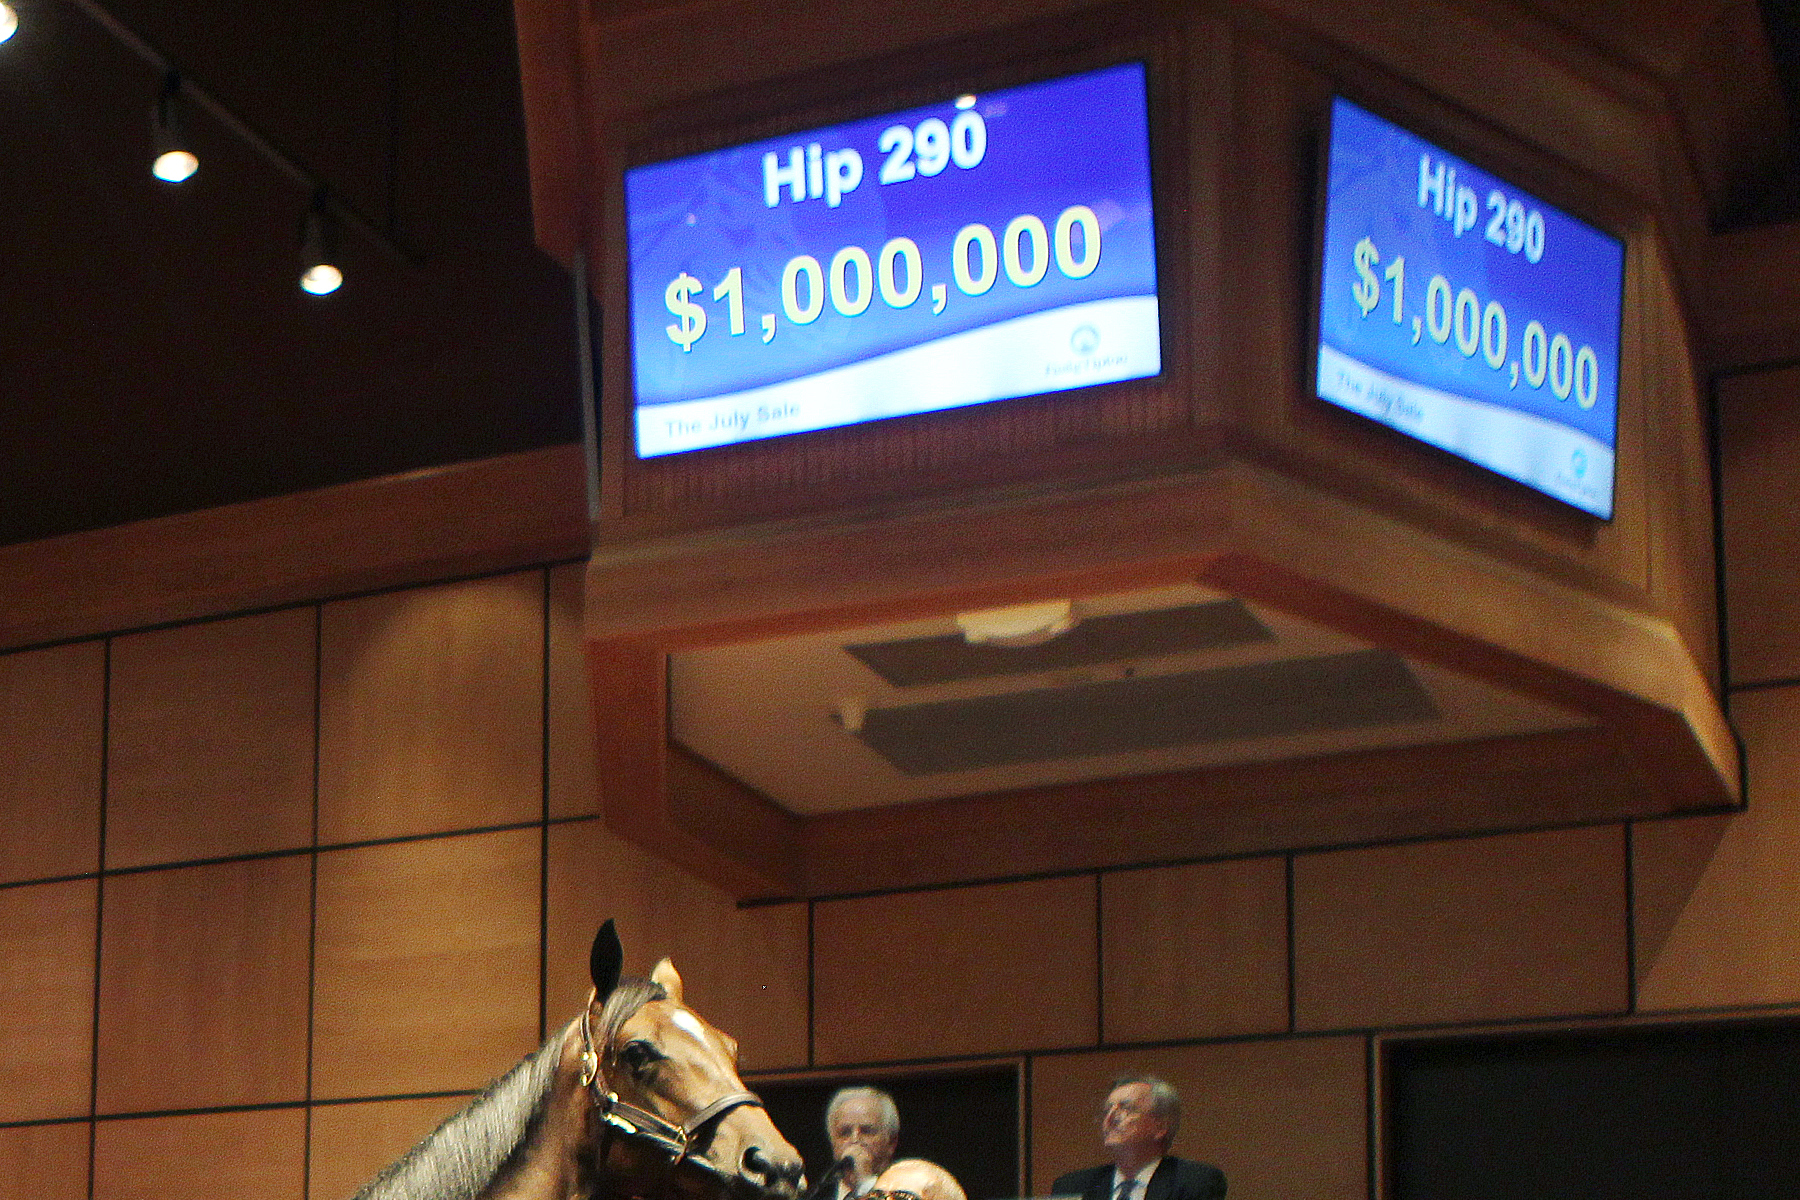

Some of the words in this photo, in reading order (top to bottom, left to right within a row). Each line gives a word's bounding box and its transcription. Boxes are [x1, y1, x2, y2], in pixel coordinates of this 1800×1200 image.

[762, 144, 864, 208] Hip
[879, 110, 987, 185] 290
[1417, 154, 1478, 238] Hip
[1485, 189, 1546, 264] 290
[663, 205, 1102, 353] $1,000,000
[1352, 236, 1598, 411] $1,000,000
[665, 420, 703, 438] The
[709, 409, 749, 431] July
[756, 401, 800, 422] Sale
